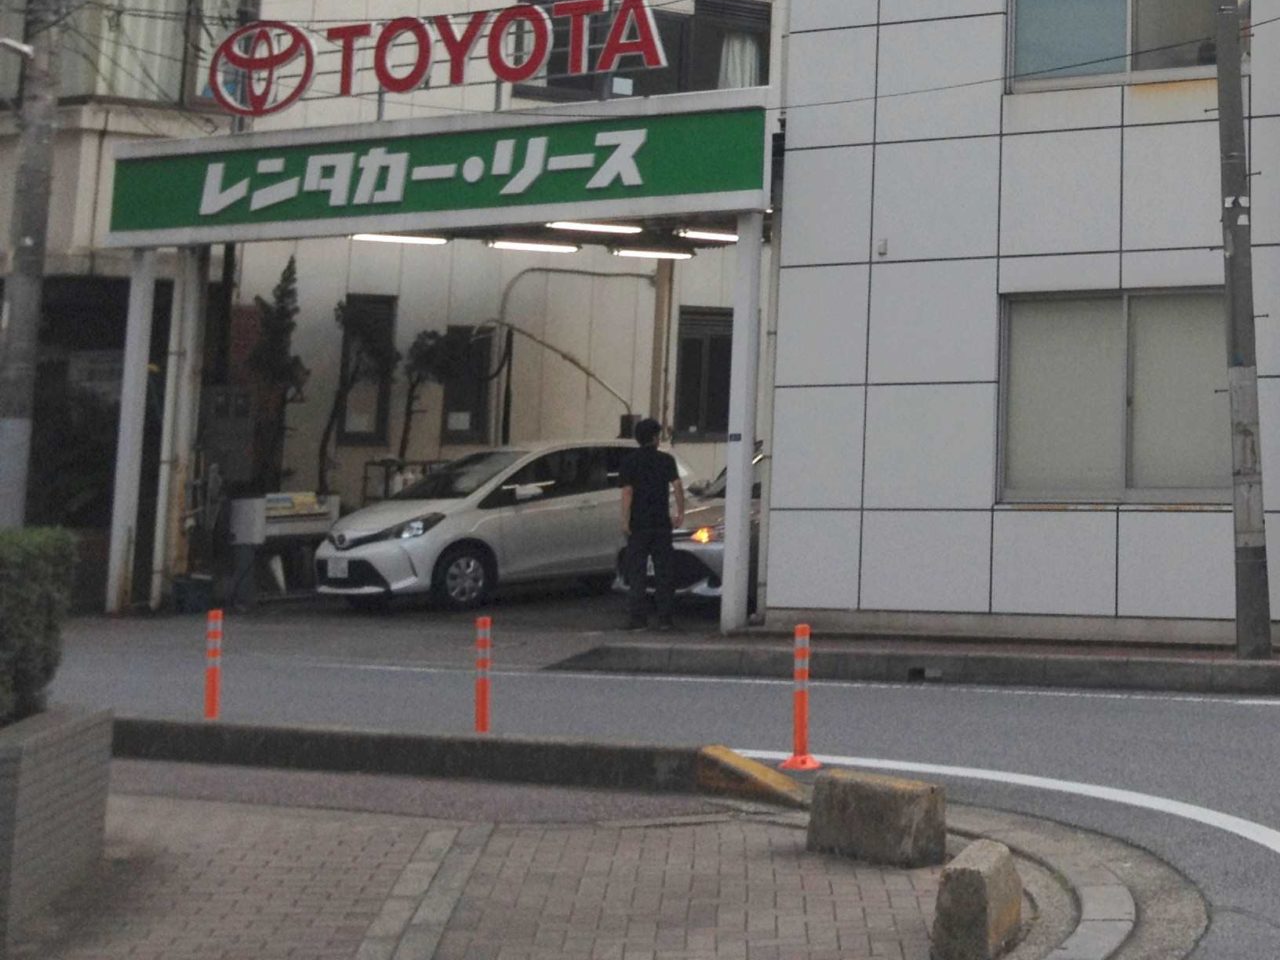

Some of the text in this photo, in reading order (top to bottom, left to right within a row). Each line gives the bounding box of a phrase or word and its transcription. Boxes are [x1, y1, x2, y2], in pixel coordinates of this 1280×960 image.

[199, 129, 648, 215] レンタカー・リース
